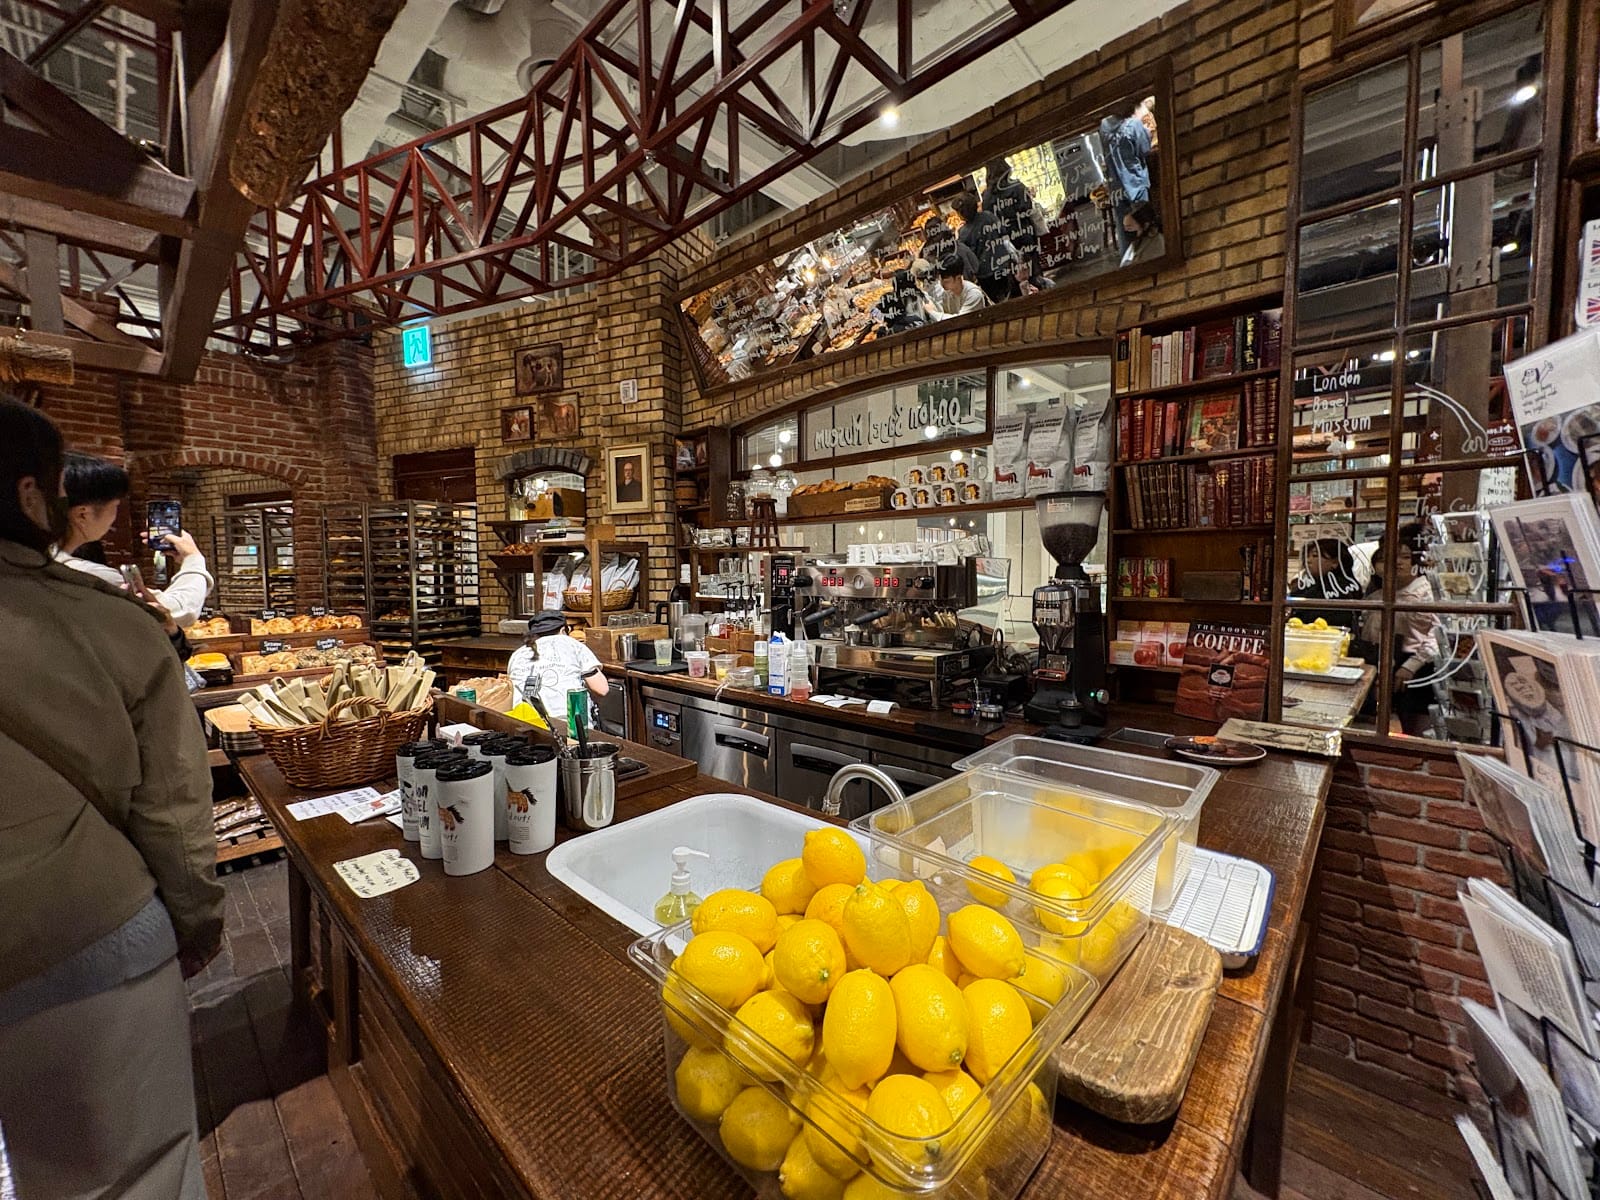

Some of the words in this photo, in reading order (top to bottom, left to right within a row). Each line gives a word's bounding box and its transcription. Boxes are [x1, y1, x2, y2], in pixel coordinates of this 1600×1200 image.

[1313, 368, 1361, 392] London
[1312, 391, 1349, 416] Bagel
[1312, 416, 1371, 434] Museum
[1197, 623, 1216, 631] THE
[1221, 625, 1247, 634] BOOK
[1193, 632, 1265, 655] COFFEE
